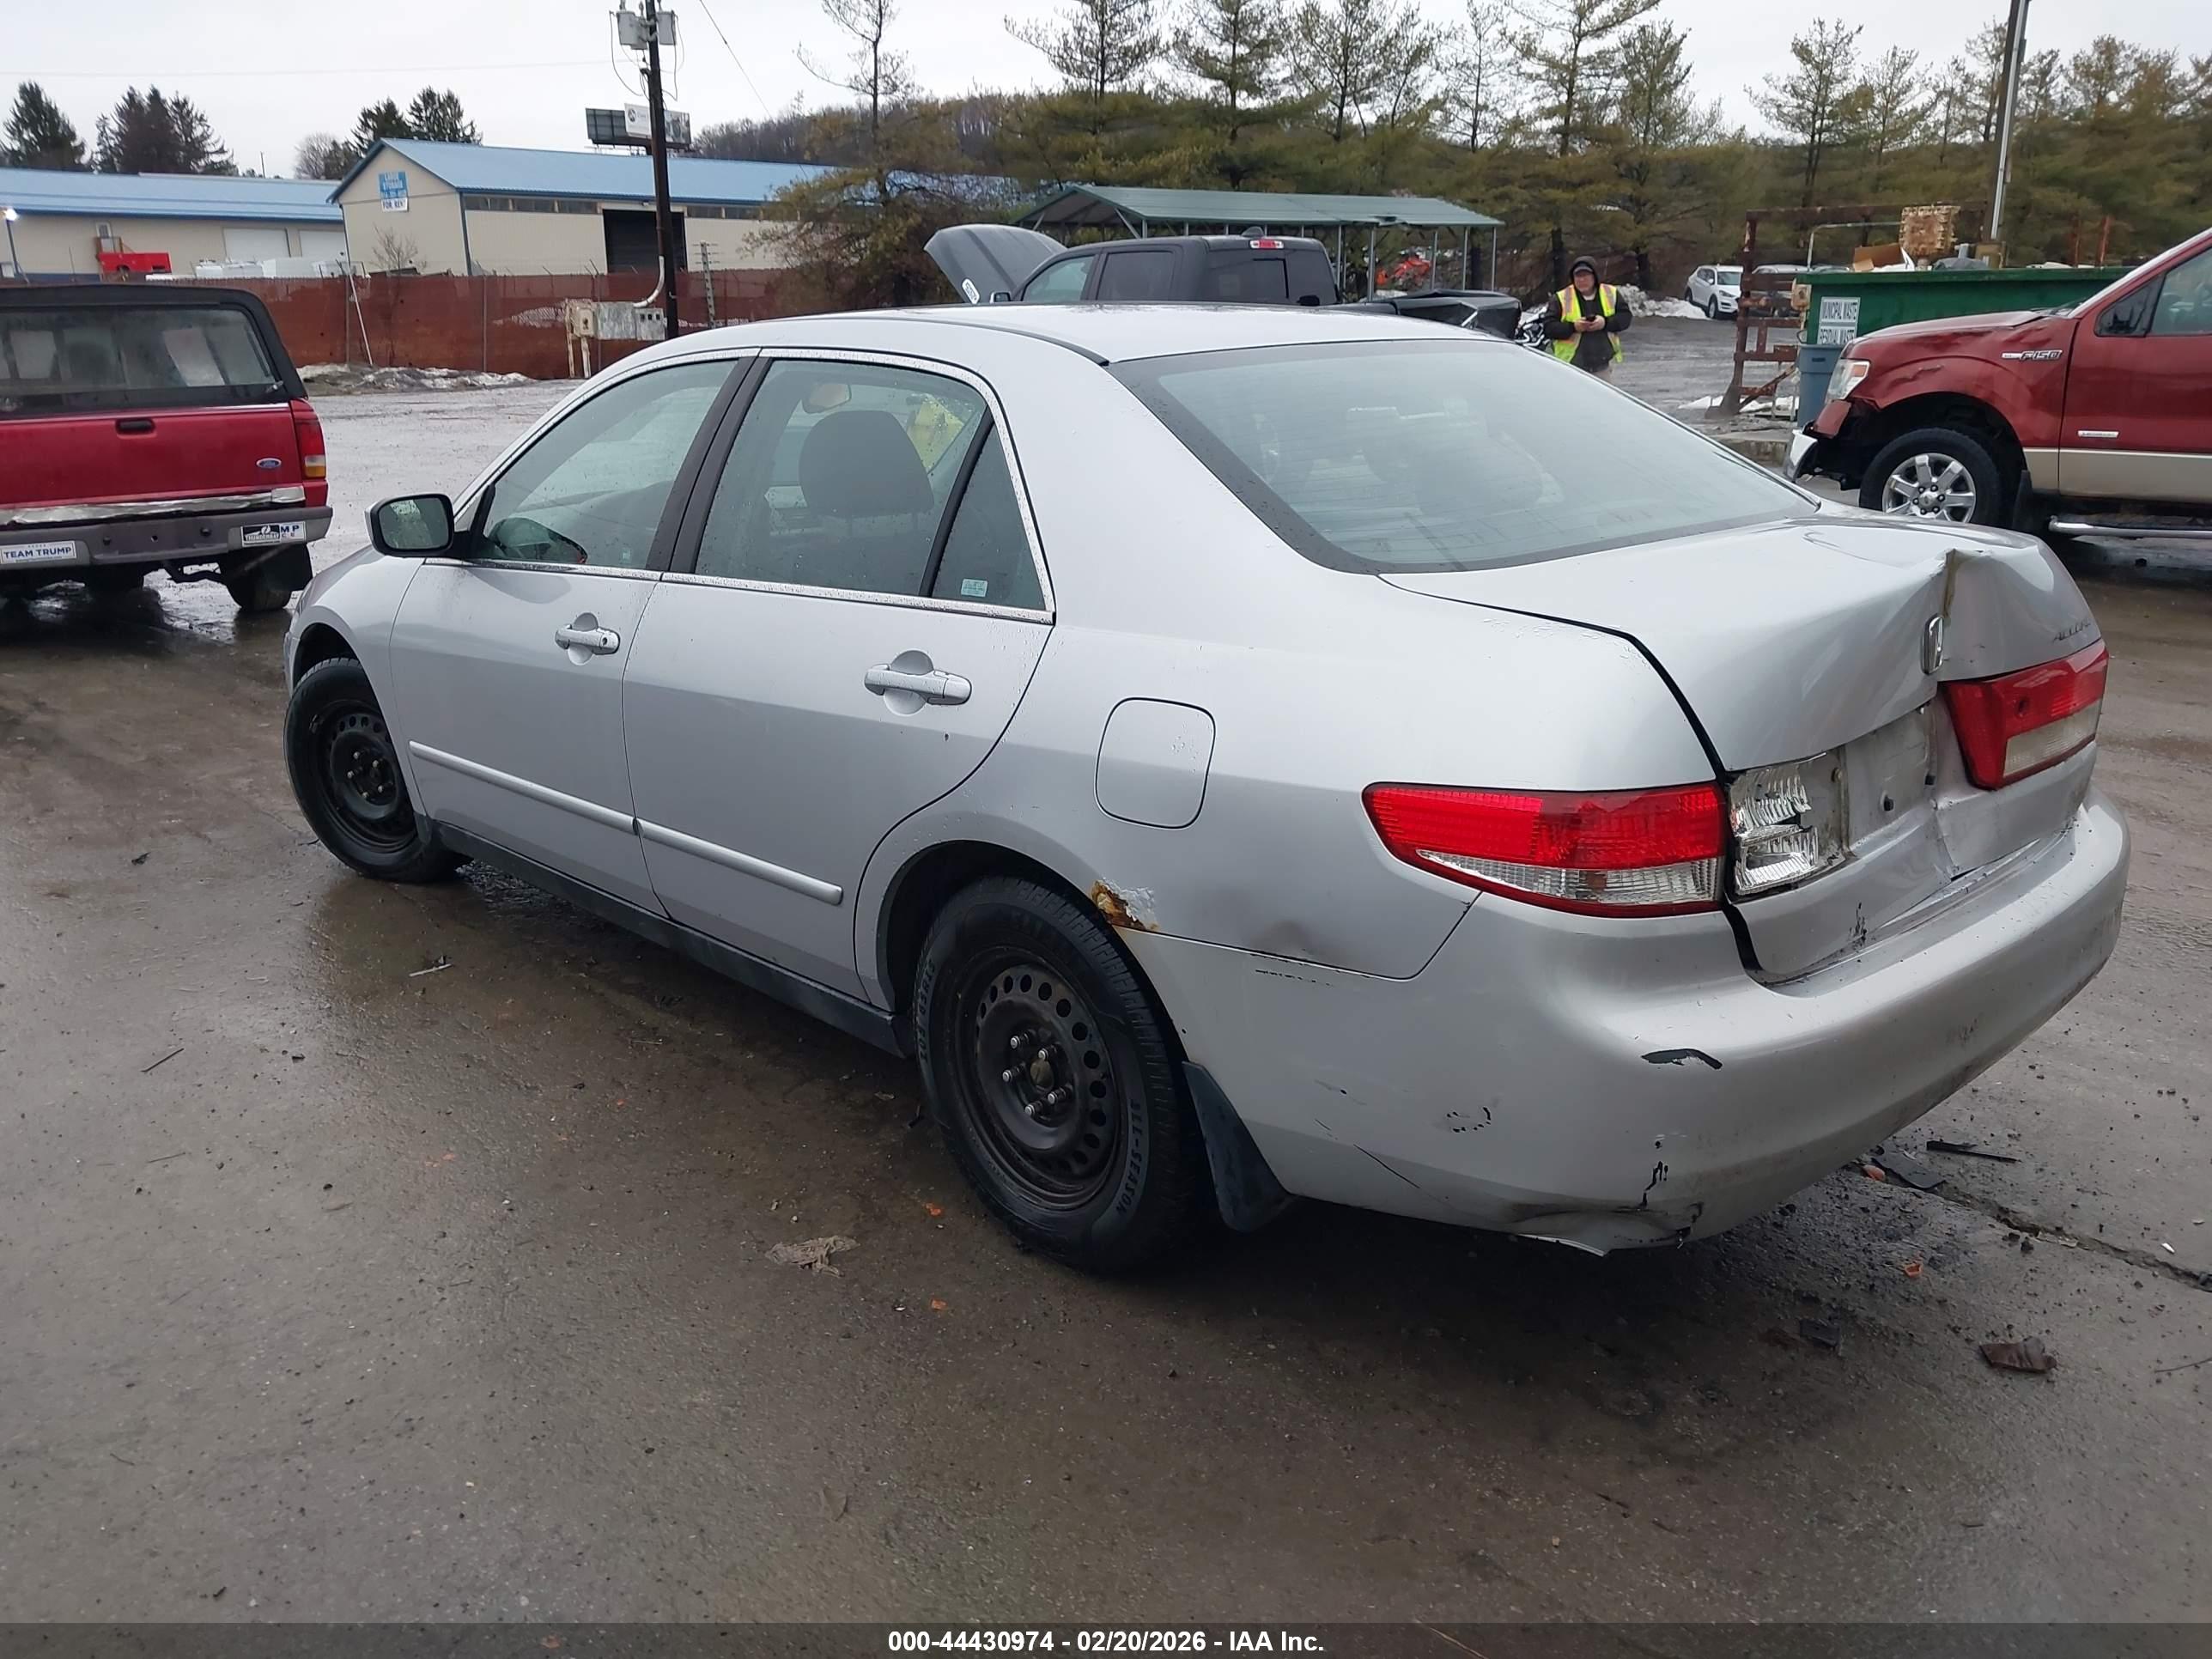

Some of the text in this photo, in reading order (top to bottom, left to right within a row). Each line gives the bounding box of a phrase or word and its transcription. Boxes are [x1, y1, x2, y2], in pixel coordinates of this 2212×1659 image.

[383, 200, 393, 210] FOR
[1822, 301, 1858, 320] MUNICIPAL WASTE
[1820, 328, 1839, 344] RESIDUAL
[3, 547, 72, 559] TEAM TRUMP
